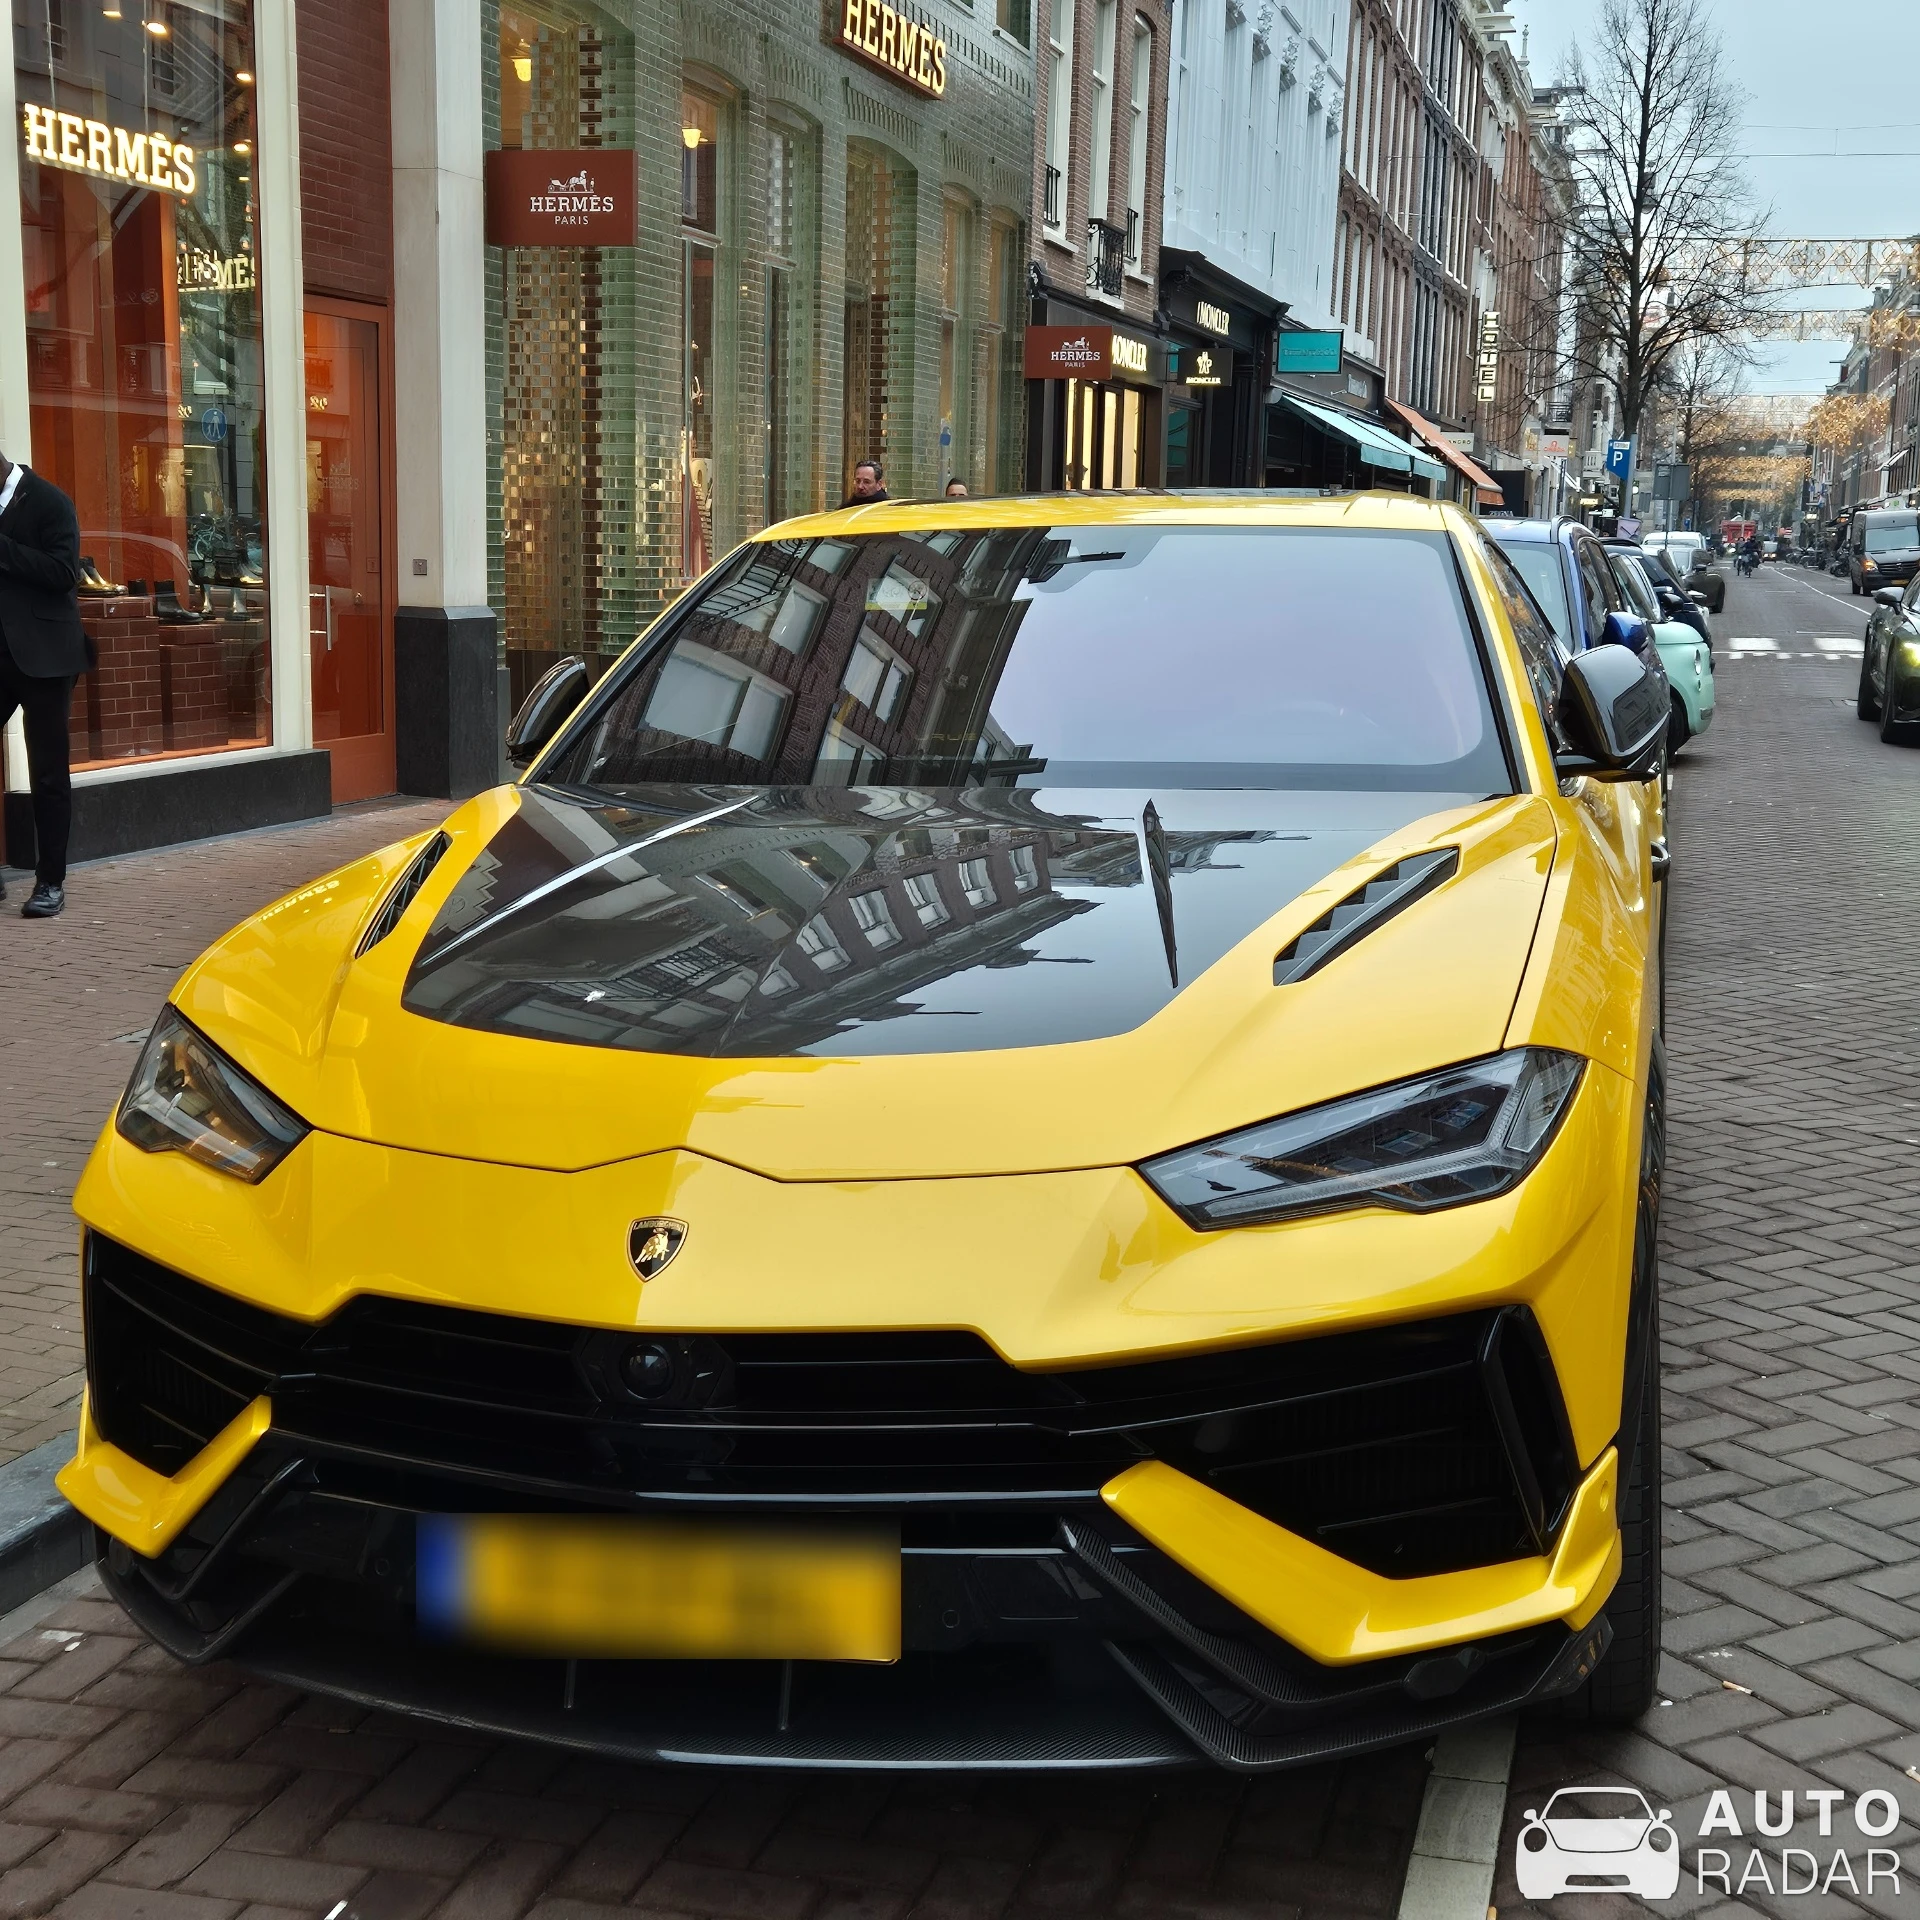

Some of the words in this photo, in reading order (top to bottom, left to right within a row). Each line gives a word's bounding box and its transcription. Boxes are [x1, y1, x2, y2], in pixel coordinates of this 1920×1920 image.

[555, 215, 589, 225] PARIS
[1197, 301, 1230, 335] MONCLER
[1480, 312, 1499, 400] HOTEL
[1613, 451, 1623, 467] P
